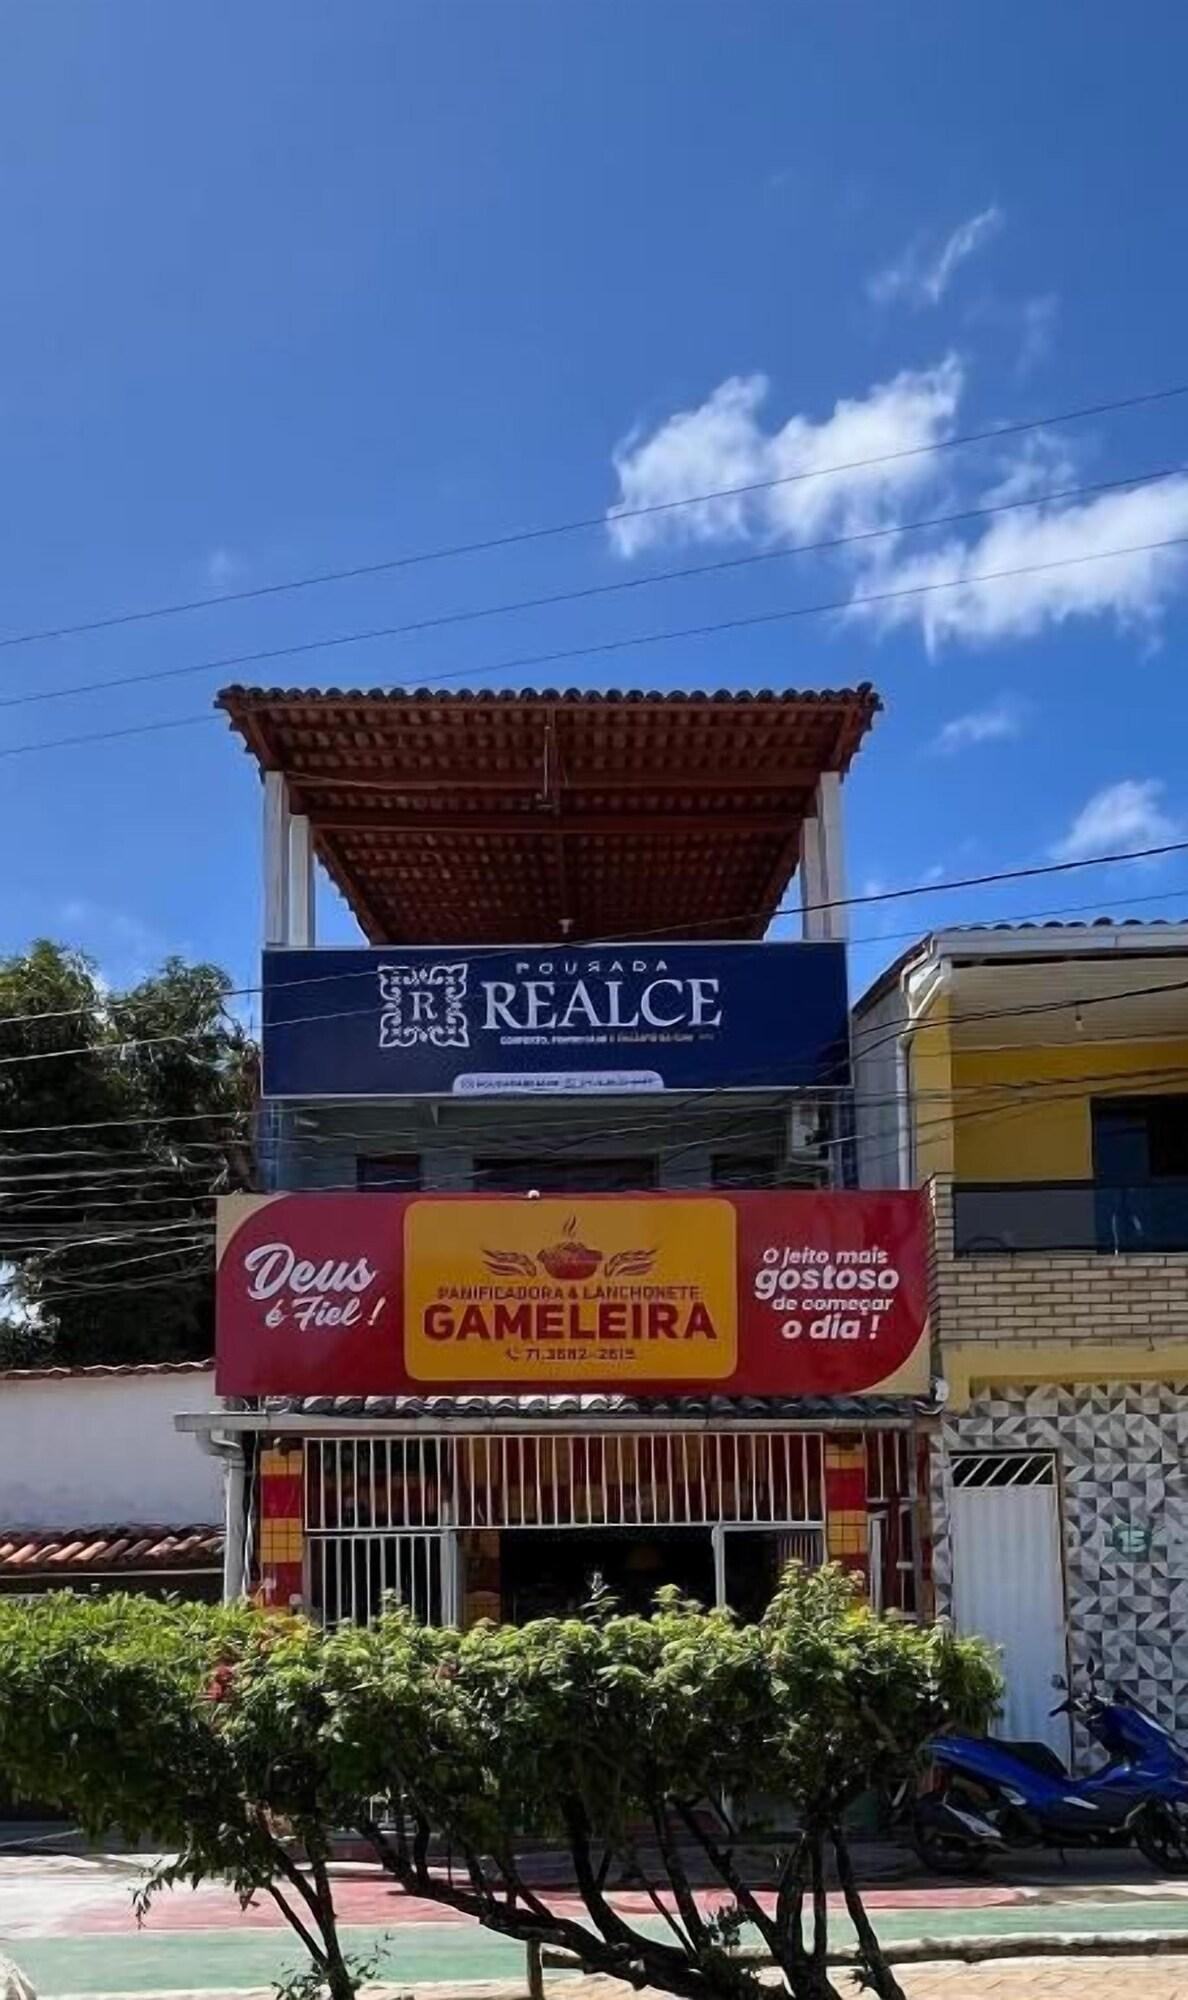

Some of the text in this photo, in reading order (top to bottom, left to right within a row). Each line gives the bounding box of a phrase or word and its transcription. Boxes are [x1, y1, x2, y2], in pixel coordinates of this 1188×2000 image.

[408, 991, 438, 1020] R
[480, 979, 722, 1030] REALCE
[244, 1243, 378, 1300] Deus
[763, 1245, 888, 1268] O jeito mais
[437, 1285, 563, 1300] PANIFICADORA
[583, 1285, 702, 1300] LANCHONETE
[754, 1265, 900, 1300] gostoso
[294, 1295, 362, 1331] Fiel
[423, 1303, 717, 1341] GAMELEIRA
[772, 1296, 894, 1316] de começar
[782, 1320, 803, 1339] o
[809, 1313, 861, 1339] dia
